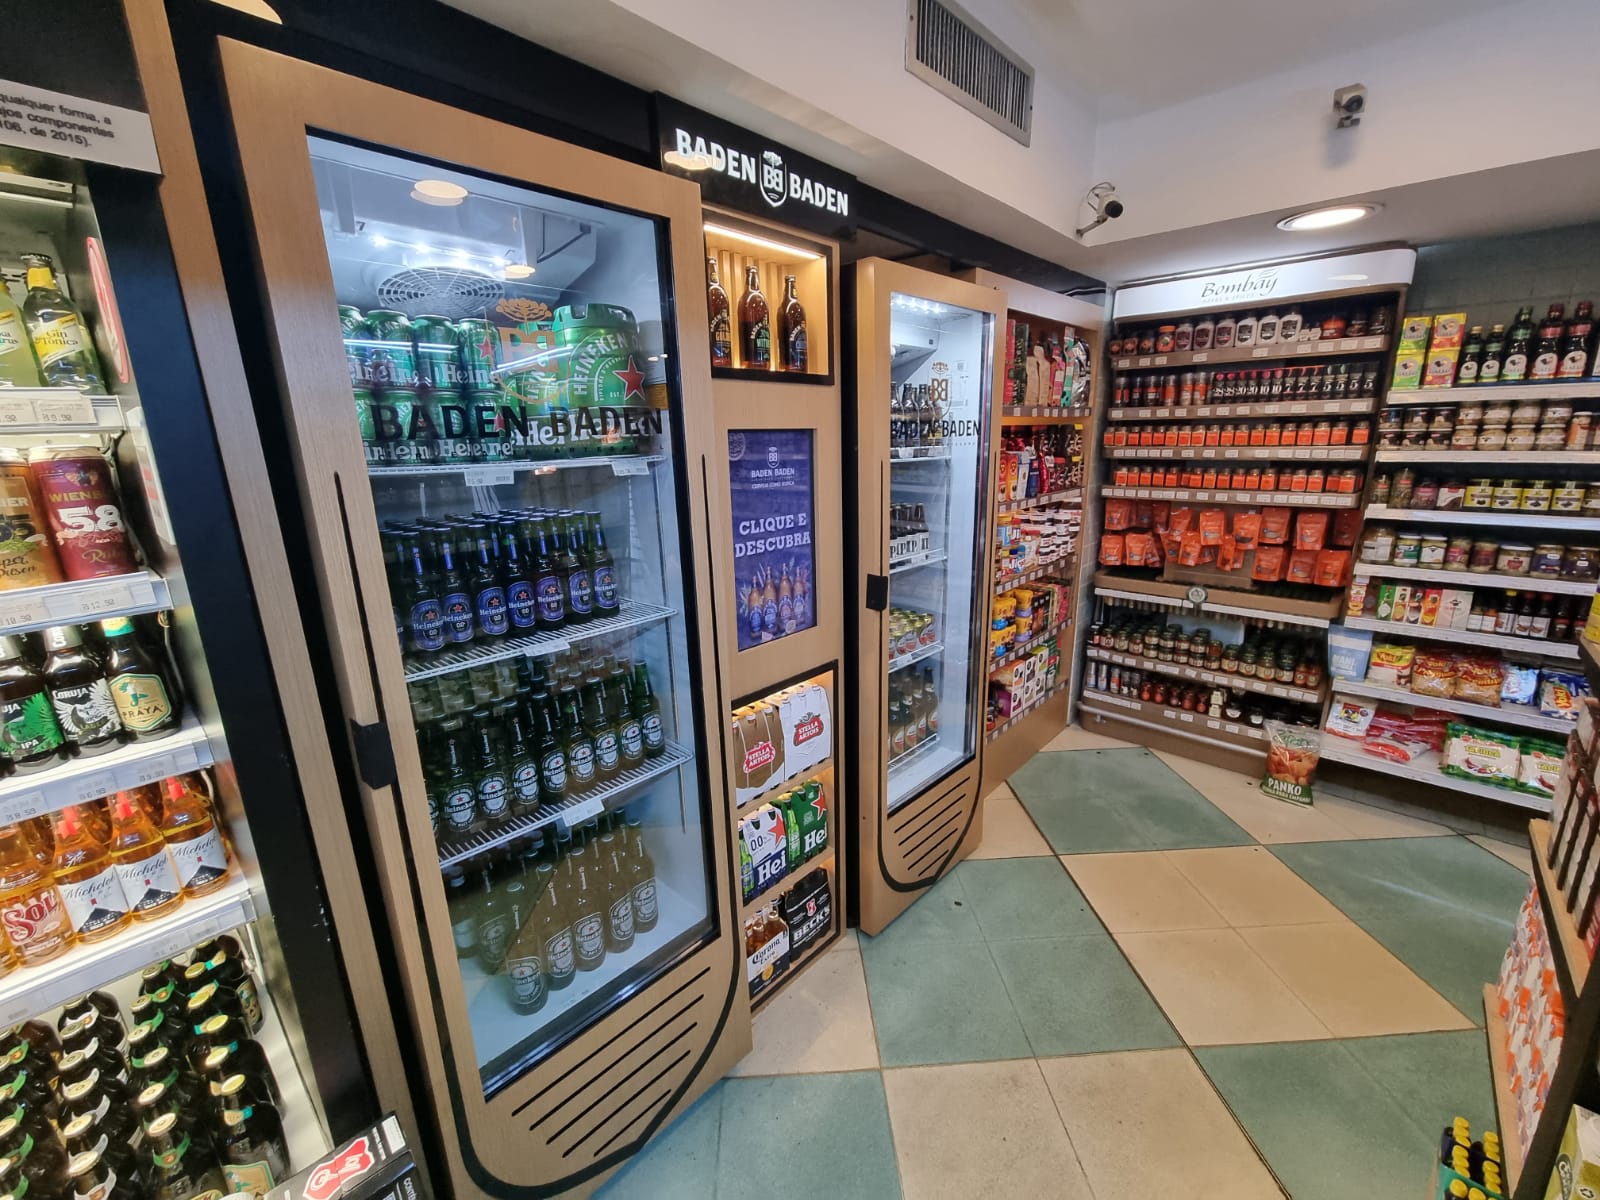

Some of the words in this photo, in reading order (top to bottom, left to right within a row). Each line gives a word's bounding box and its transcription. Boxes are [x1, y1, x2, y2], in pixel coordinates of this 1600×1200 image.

[27, 114, 114, 138] componentes
[59, 105, 100, 123] forma,
[104, 117, 112, 125] a
[30, 126, 47, 137] de
[50, 130, 92, 148] 2015).
[676, 128, 756, 184] BADEN
[789, 173, 849, 216] BADEN
[1201, 273, 1279, 298] Bombay
[368, 404, 529, 441] BADEN
[550, 404, 663, 438] BADEN
[942, 420, 980, 438] BADEN
[751, 470, 773, 478] BADEN
[775, 468, 795, 476] BADEN
[739, 516, 794, 535] CLIQUE
[798, 512, 807, 526] E
[735, 532, 811, 558] DESCUBRA
[121, 704, 163, 719] PRAYA
[799, 722, 818, 735] STELLA
[799, 728, 820, 741] ARTOIS
[20, 739, 40, 749] IPA
[749, 746, 770, 760] STELLA
[1268, 777, 1302, 796] PANKO
[3, 893, 58, 941] SOL
[752, 938, 780, 965] Corona
